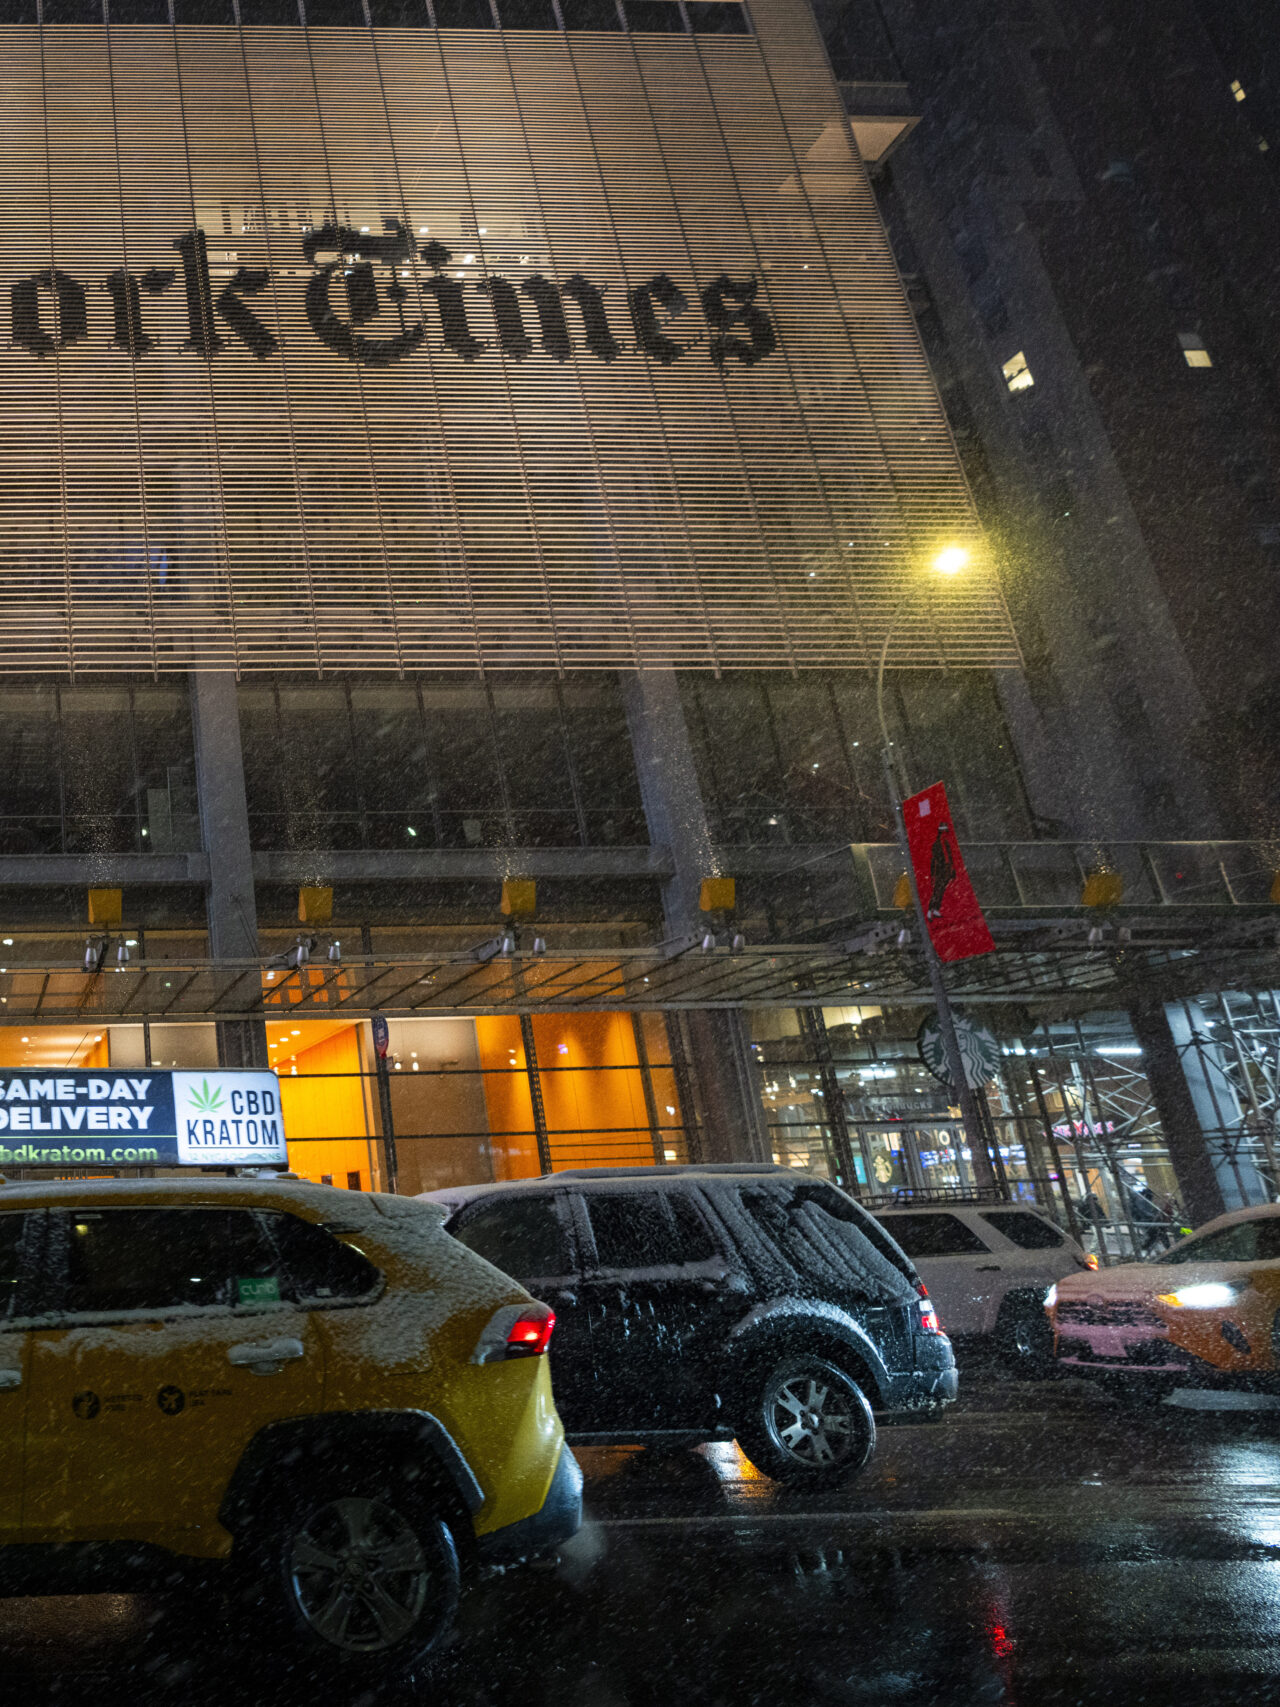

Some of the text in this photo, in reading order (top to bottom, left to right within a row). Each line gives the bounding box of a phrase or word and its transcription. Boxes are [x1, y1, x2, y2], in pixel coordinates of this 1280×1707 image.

[303, 219, 777, 376] Times
[231, 1089, 275, 1117] CBD
[186, 1118, 279, 1146] KRATOM
